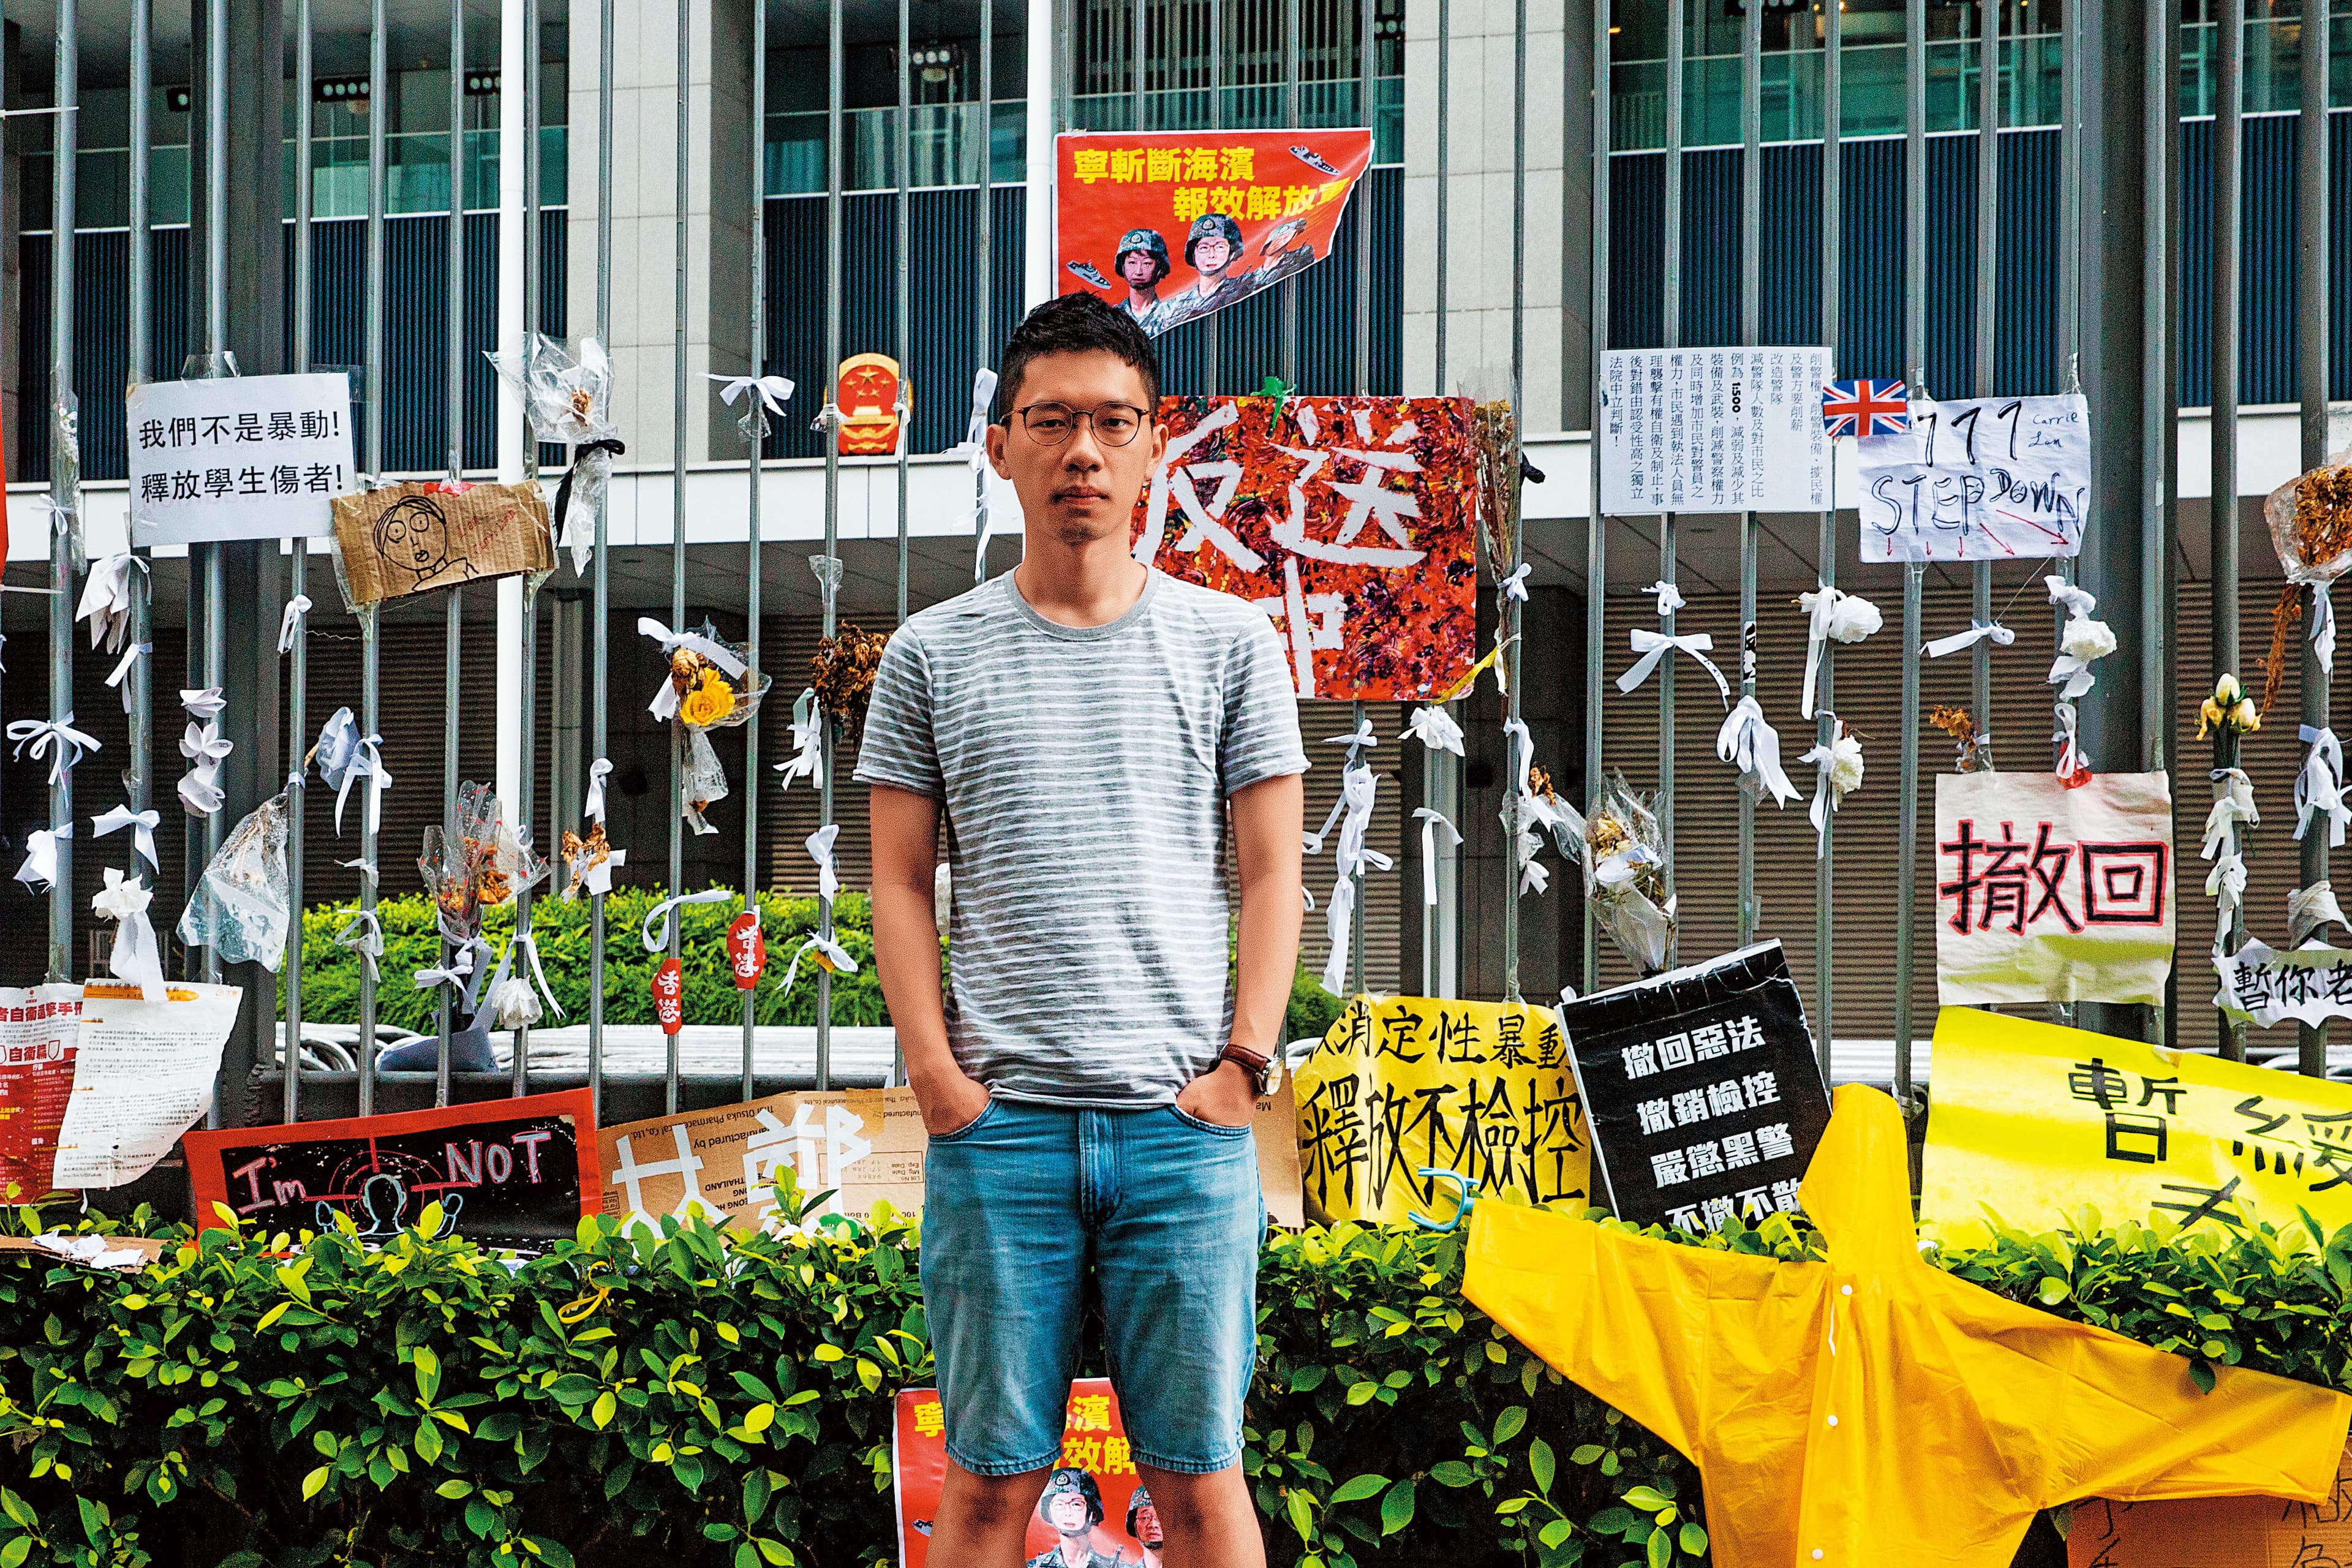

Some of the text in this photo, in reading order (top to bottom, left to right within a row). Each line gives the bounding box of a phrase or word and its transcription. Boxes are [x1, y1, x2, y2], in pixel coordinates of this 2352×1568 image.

[1073, 146, 1254, 184] 寧斬斷海濱
[1173, 176, 1351, 222] 報效解放軍
[1770, 353, 1784, 405] 改造警隊
[2028, 431, 2064, 448] Lam
[2032, 412, 2080, 426] Carrie
[1871, 468, 2085, 537] STEP DOWN
[1621, 1014, 1766, 1082] 撤回惡法
[1636, 1070, 1782, 1136] 撤銷檢控
[445, 1129, 552, 1186] NOT
[693, 1139, 706, 1150] by
[1302, 1072, 1586, 1212] 釋放不檢控
[1650, 1121, 1795, 1189] 嚴懲黑警
[704, 1176, 745, 1193] THAILAND
[1065, 1393, 1111, 1433] 濱
[1054, 1434, 1137, 1476] 效解
